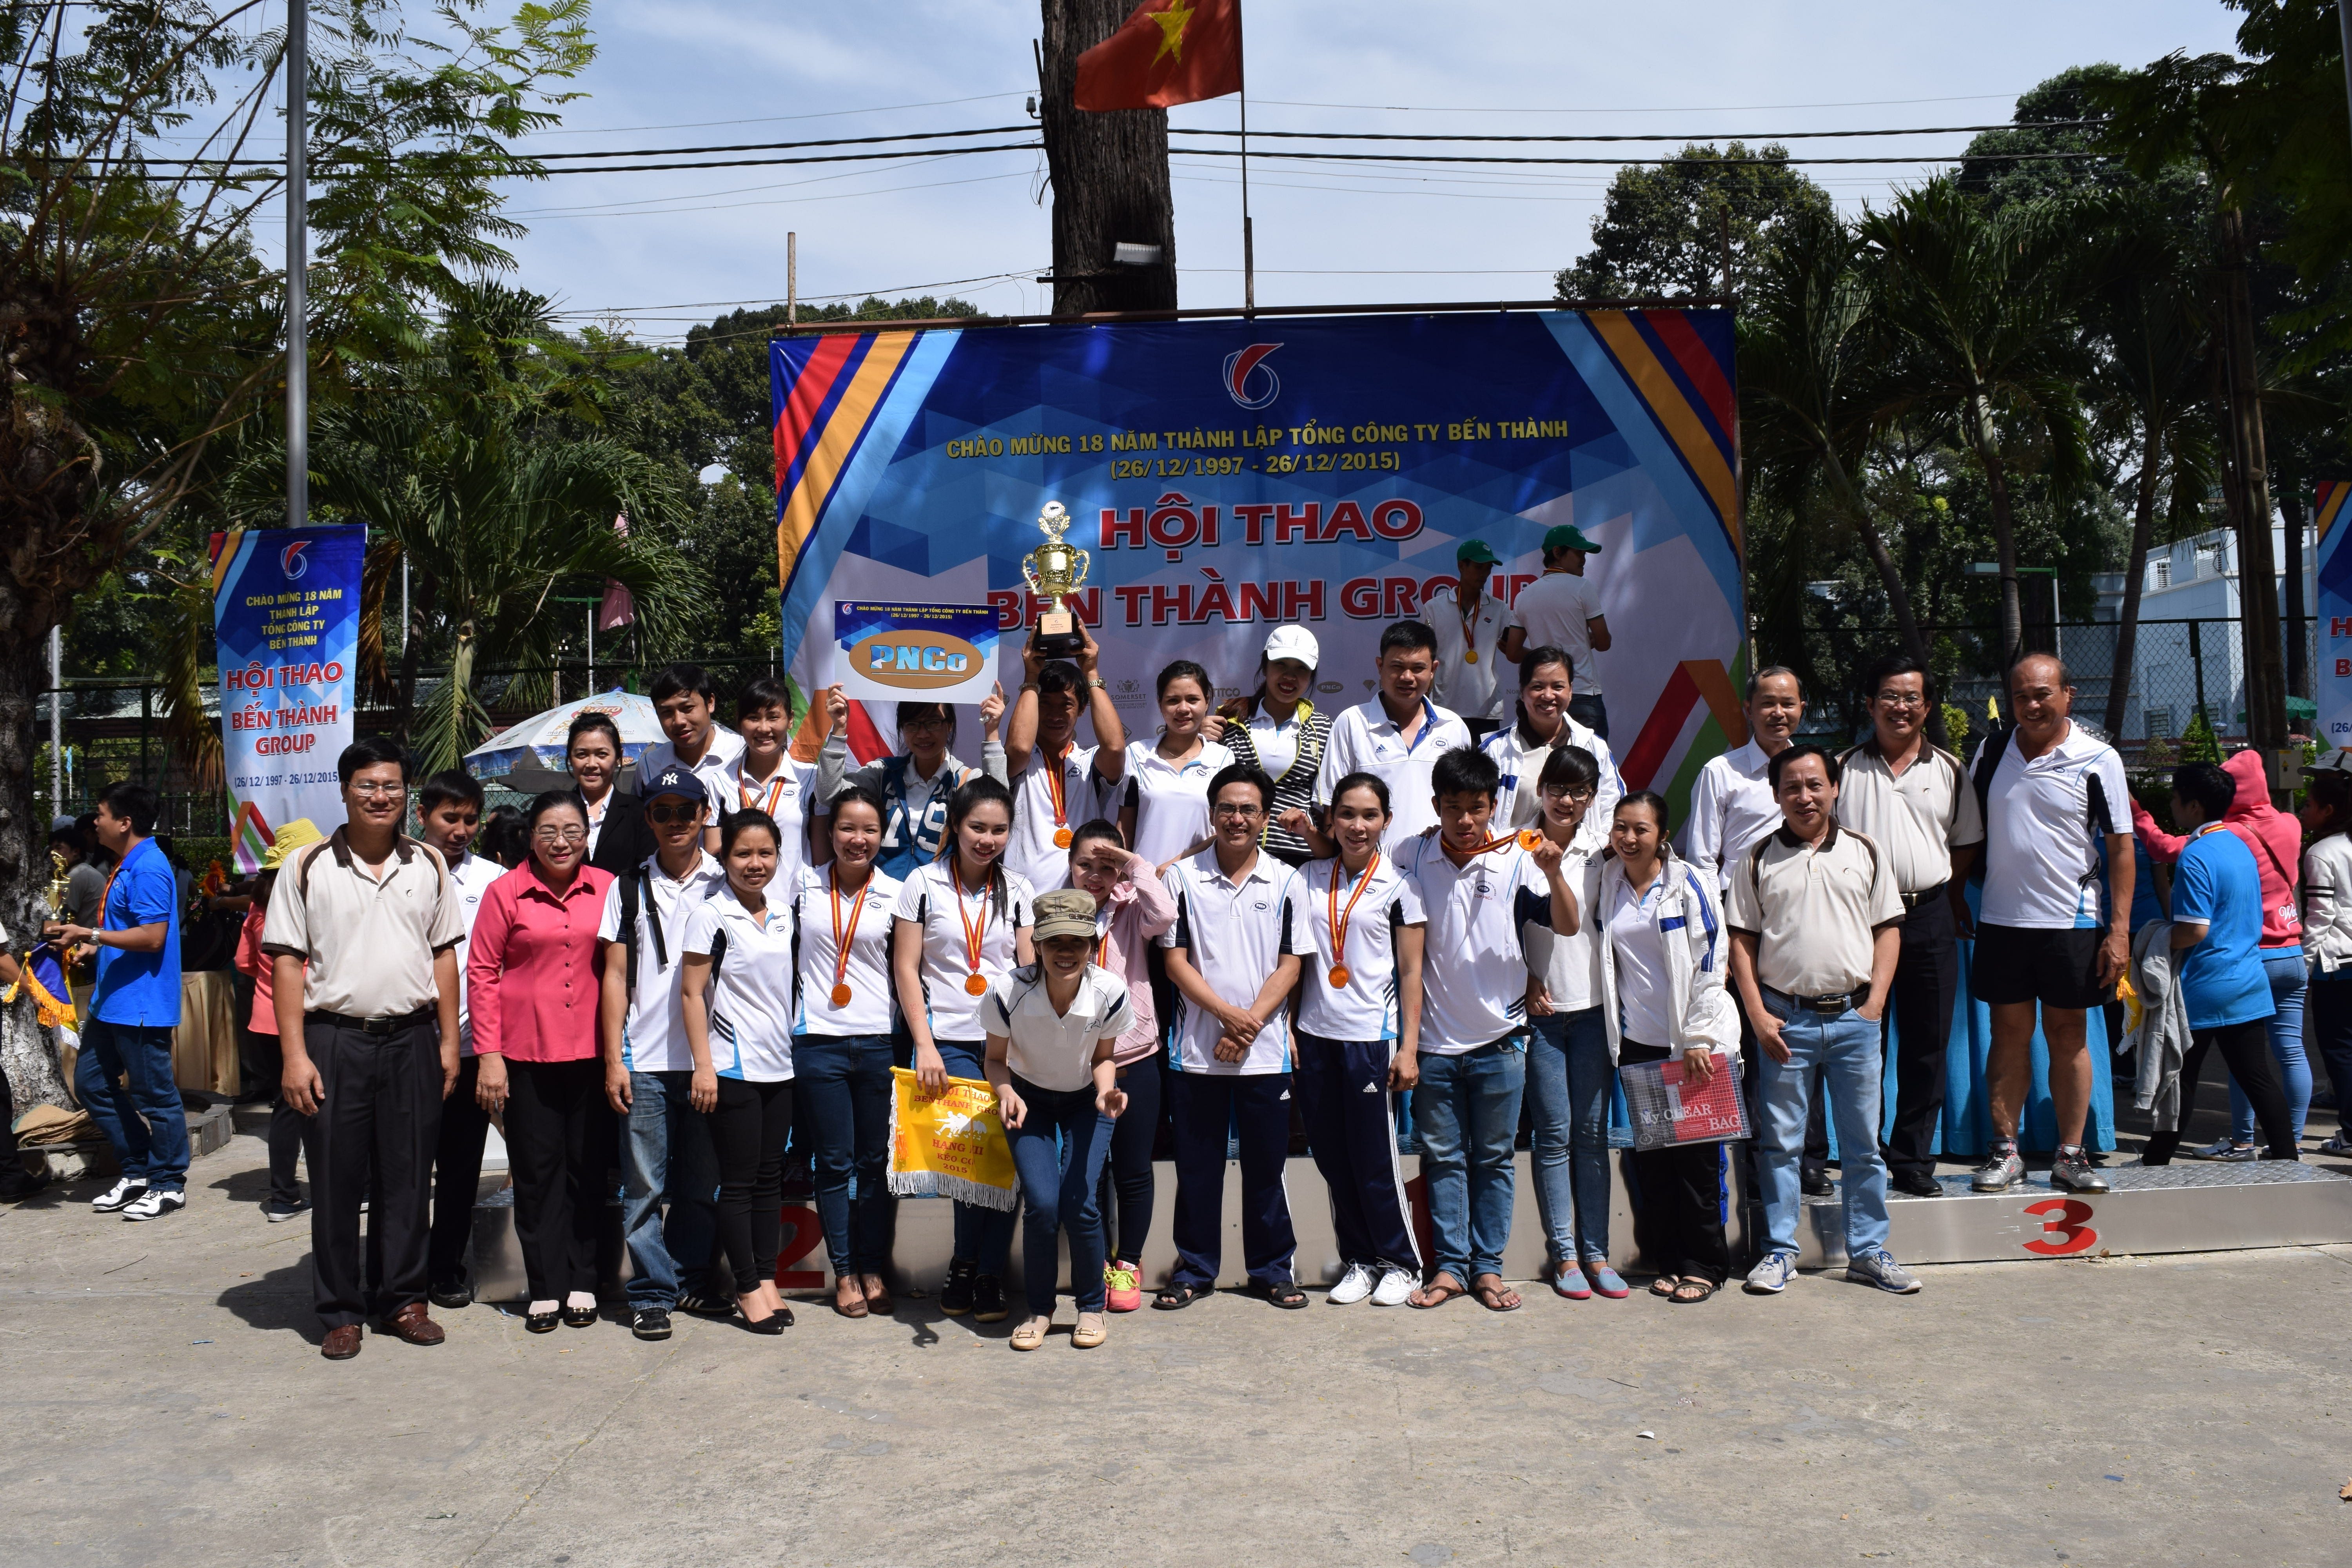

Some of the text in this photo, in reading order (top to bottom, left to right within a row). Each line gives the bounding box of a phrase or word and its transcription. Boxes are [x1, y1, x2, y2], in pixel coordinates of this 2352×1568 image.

[946, 416, 1568, 459] CHÀO MỪNG 18 NĂM THÀNH LẬP TỔNG CÔNG TY BẾN THÀNH
[1100, 492, 1424, 563] HỘI THAO
[246, 588, 342, 607] CHÀO MỪNG 18 NĂM
[1115, 567, 1327, 627] THÀNH
[269, 604, 319, 620] THÀNH LẬP
[261, 619, 325, 635] TỔNG CÔNG TY
[269, 633, 318, 650] BẾN THÀNH
[870, 644, 967, 672] PNCo
[226, 661, 344, 697] HỘI THAO
[232, 700, 338, 731] BẾN THÀNH
[255, 733, 316, 757] GROUP
[1708, 1114, 1741, 1131] BAG
[932, 1138, 966, 1152] HẠNG
[937, 1152, 958, 1163] KÉO
[943, 1163, 968, 1174] 2015
[2022, 1198, 2097, 1255] 3
[774, 1205, 825, 1289] 2
